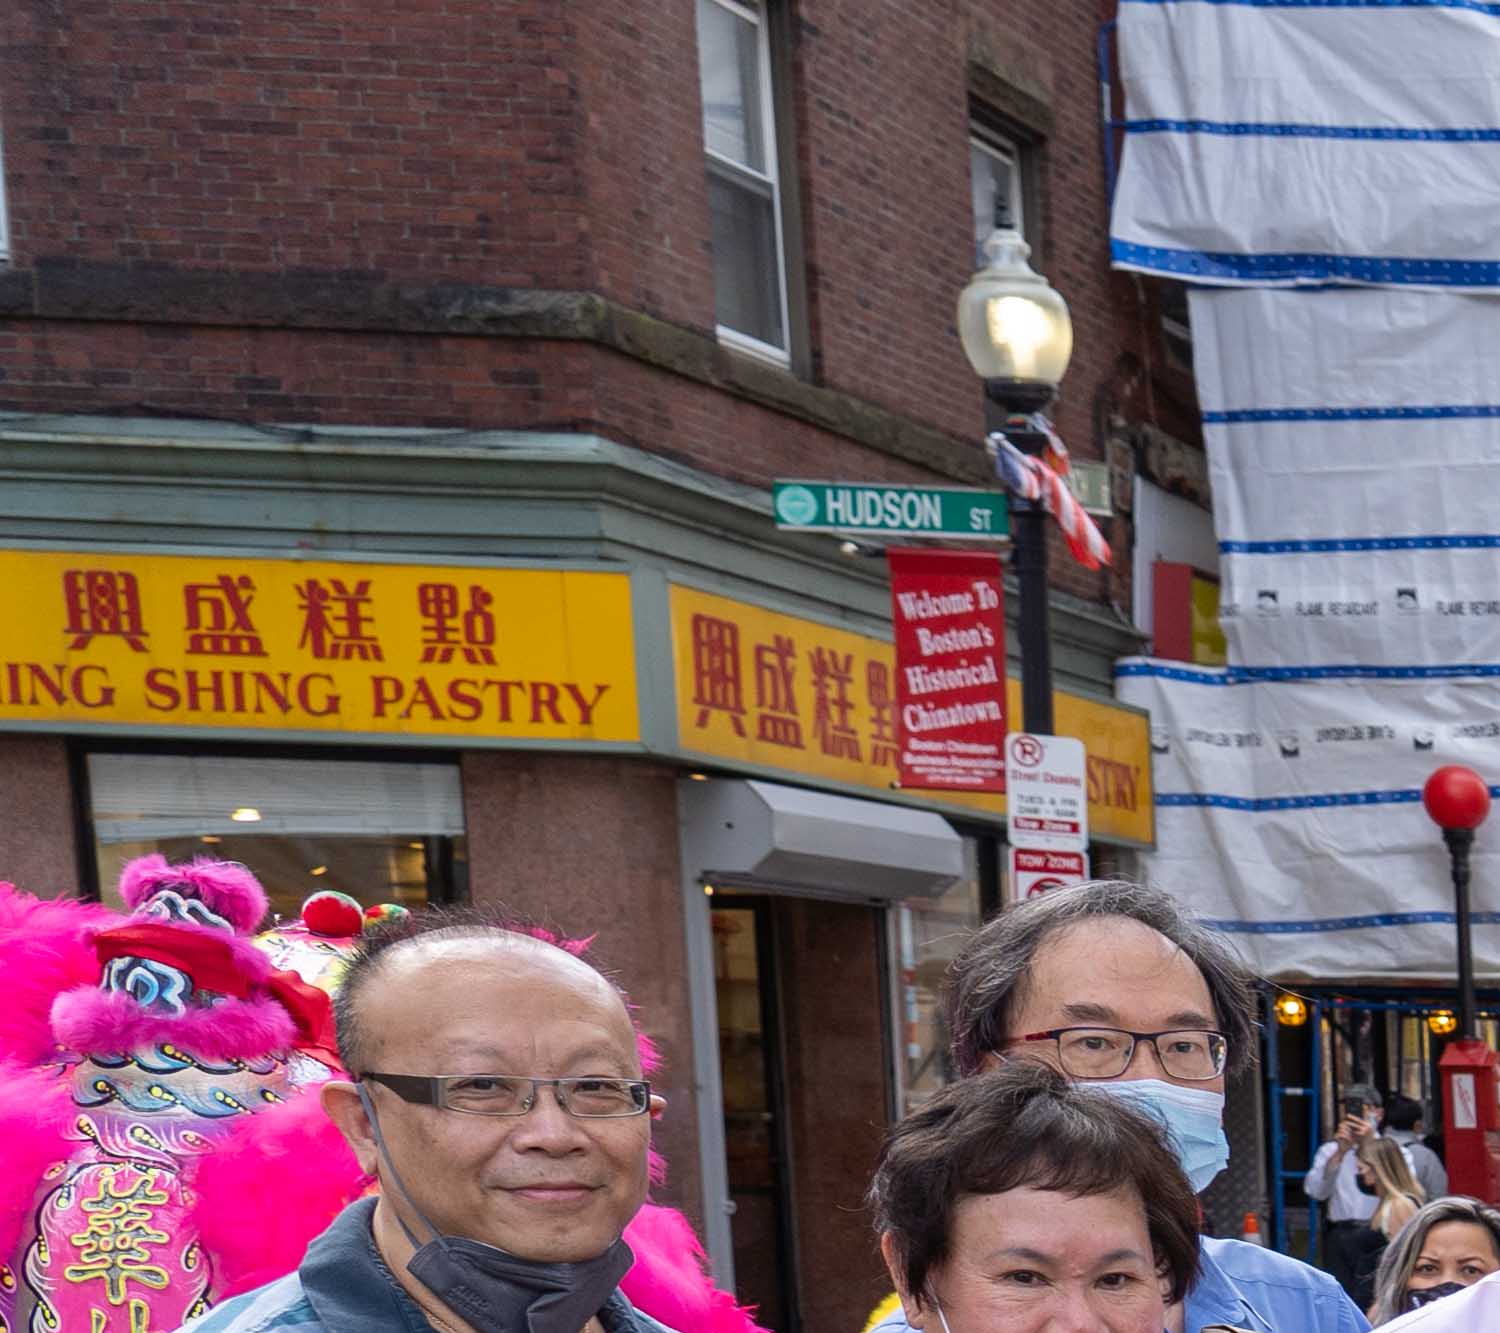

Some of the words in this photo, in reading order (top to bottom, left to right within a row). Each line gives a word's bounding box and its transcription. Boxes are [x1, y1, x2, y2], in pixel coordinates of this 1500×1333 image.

[827, 488, 942, 529] HUDSON
[970, 507, 993, 532] ST
[62, 569, 498, 666] 興盛糕點
[897, 589, 975, 621] Welcome
[972, 580, 999, 610] To
[916, 621, 995, 656] Boston's
[904, 655, 999, 695] Historical
[144, 668, 342, 717] SHING
[371, 675, 611, 725] PASTRY
[902, 699, 1003, 733] Chinatown
